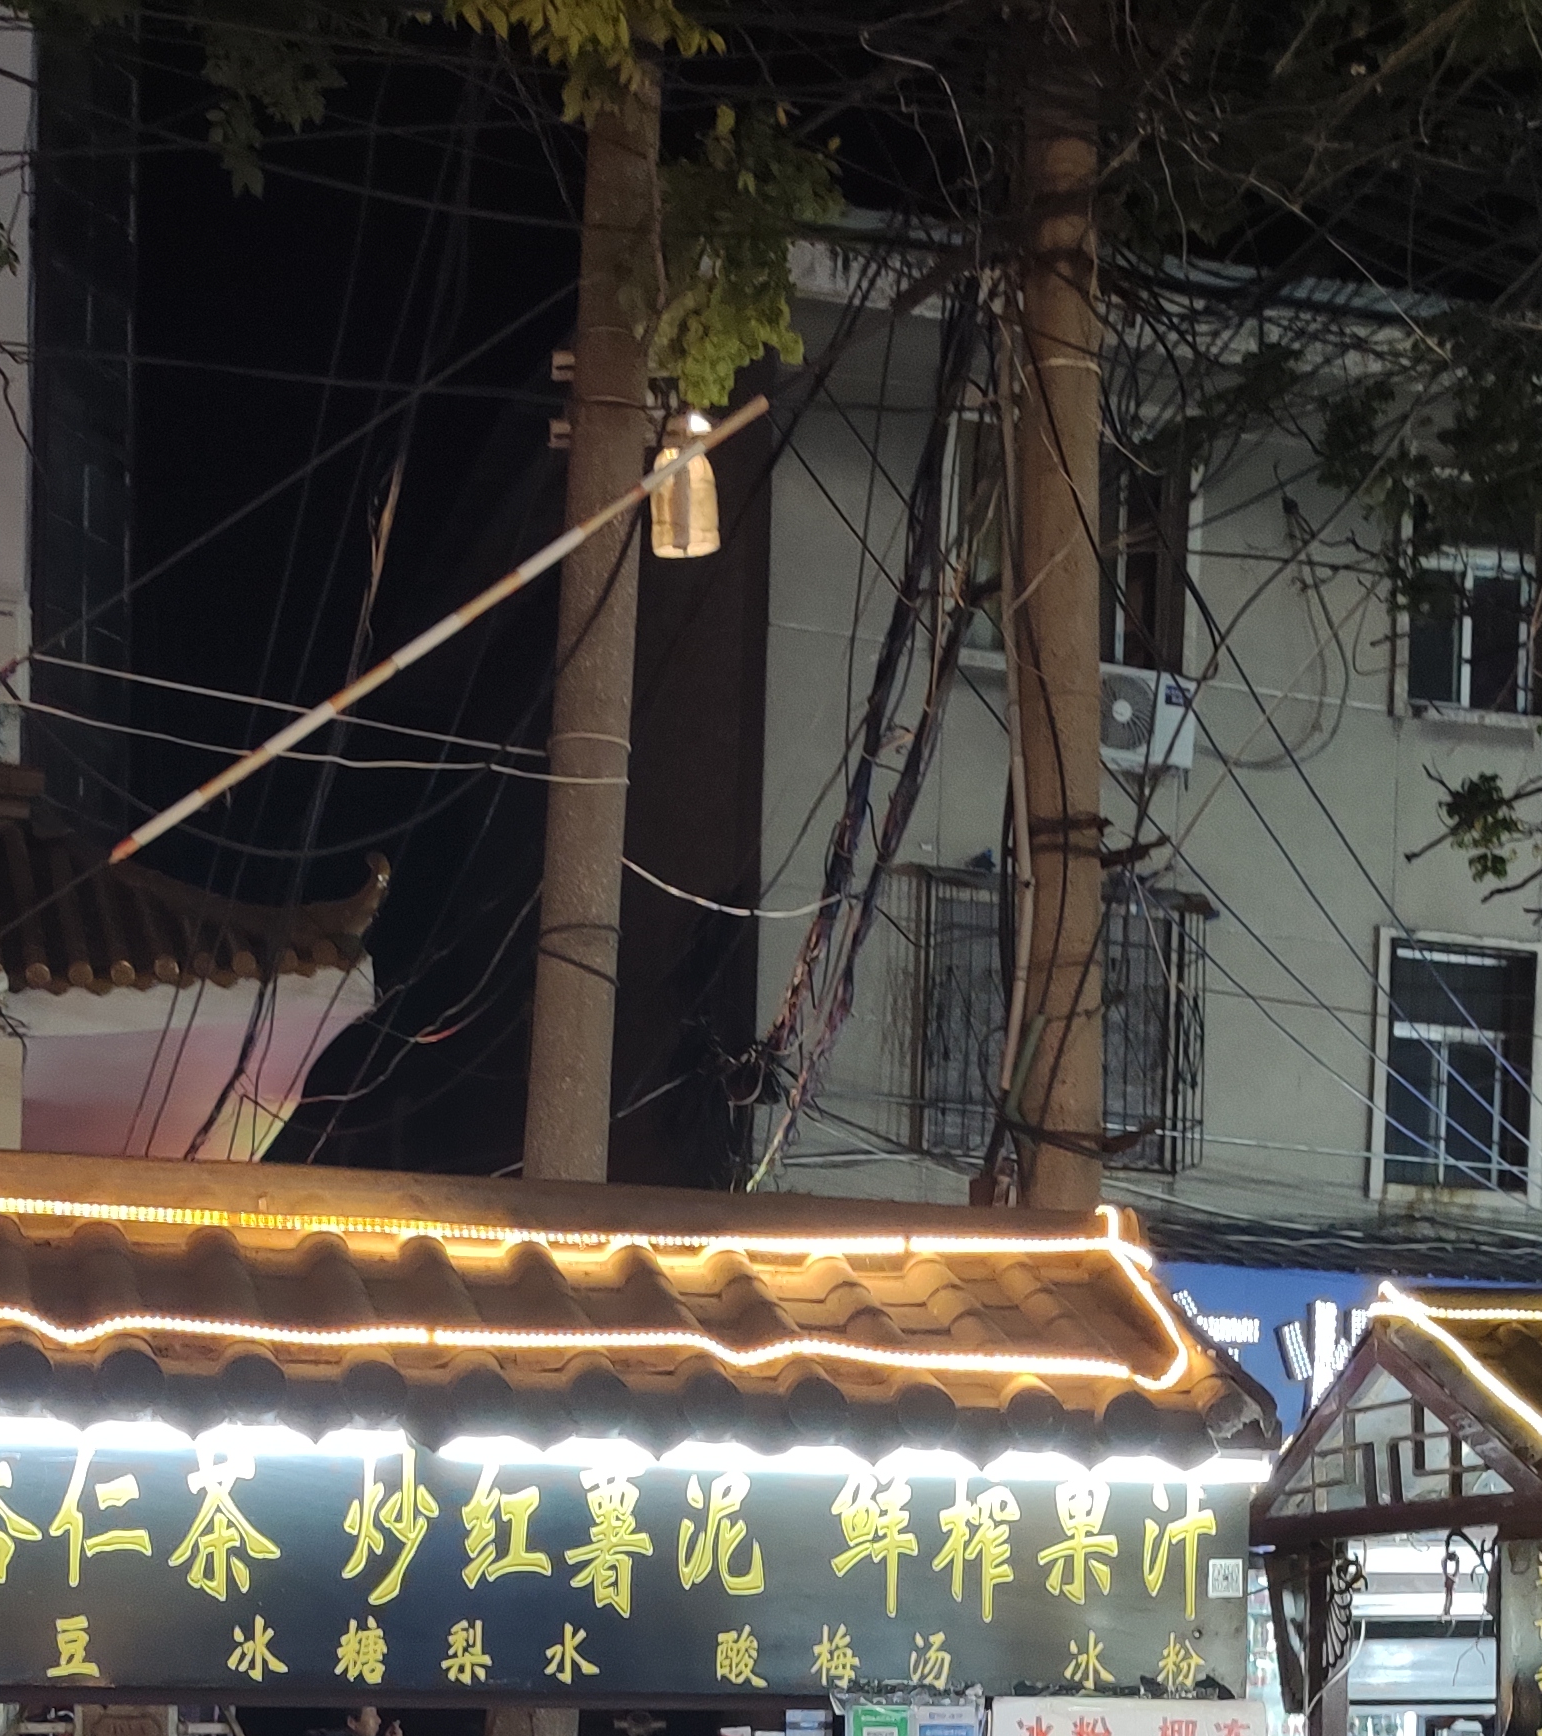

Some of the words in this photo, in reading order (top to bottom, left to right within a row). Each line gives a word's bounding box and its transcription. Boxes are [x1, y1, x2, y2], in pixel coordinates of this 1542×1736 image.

[341, 1447, 766, 1618] 炒红薯泥
[831, 1471, 1218, 1622] 鲜榨果汁
[227, 1615, 601, 1686] 冰糖梨水
[715, 1629, 953, 1690] 酸梅汤
[1065, 1630, 1205, 1690] 冰粉
